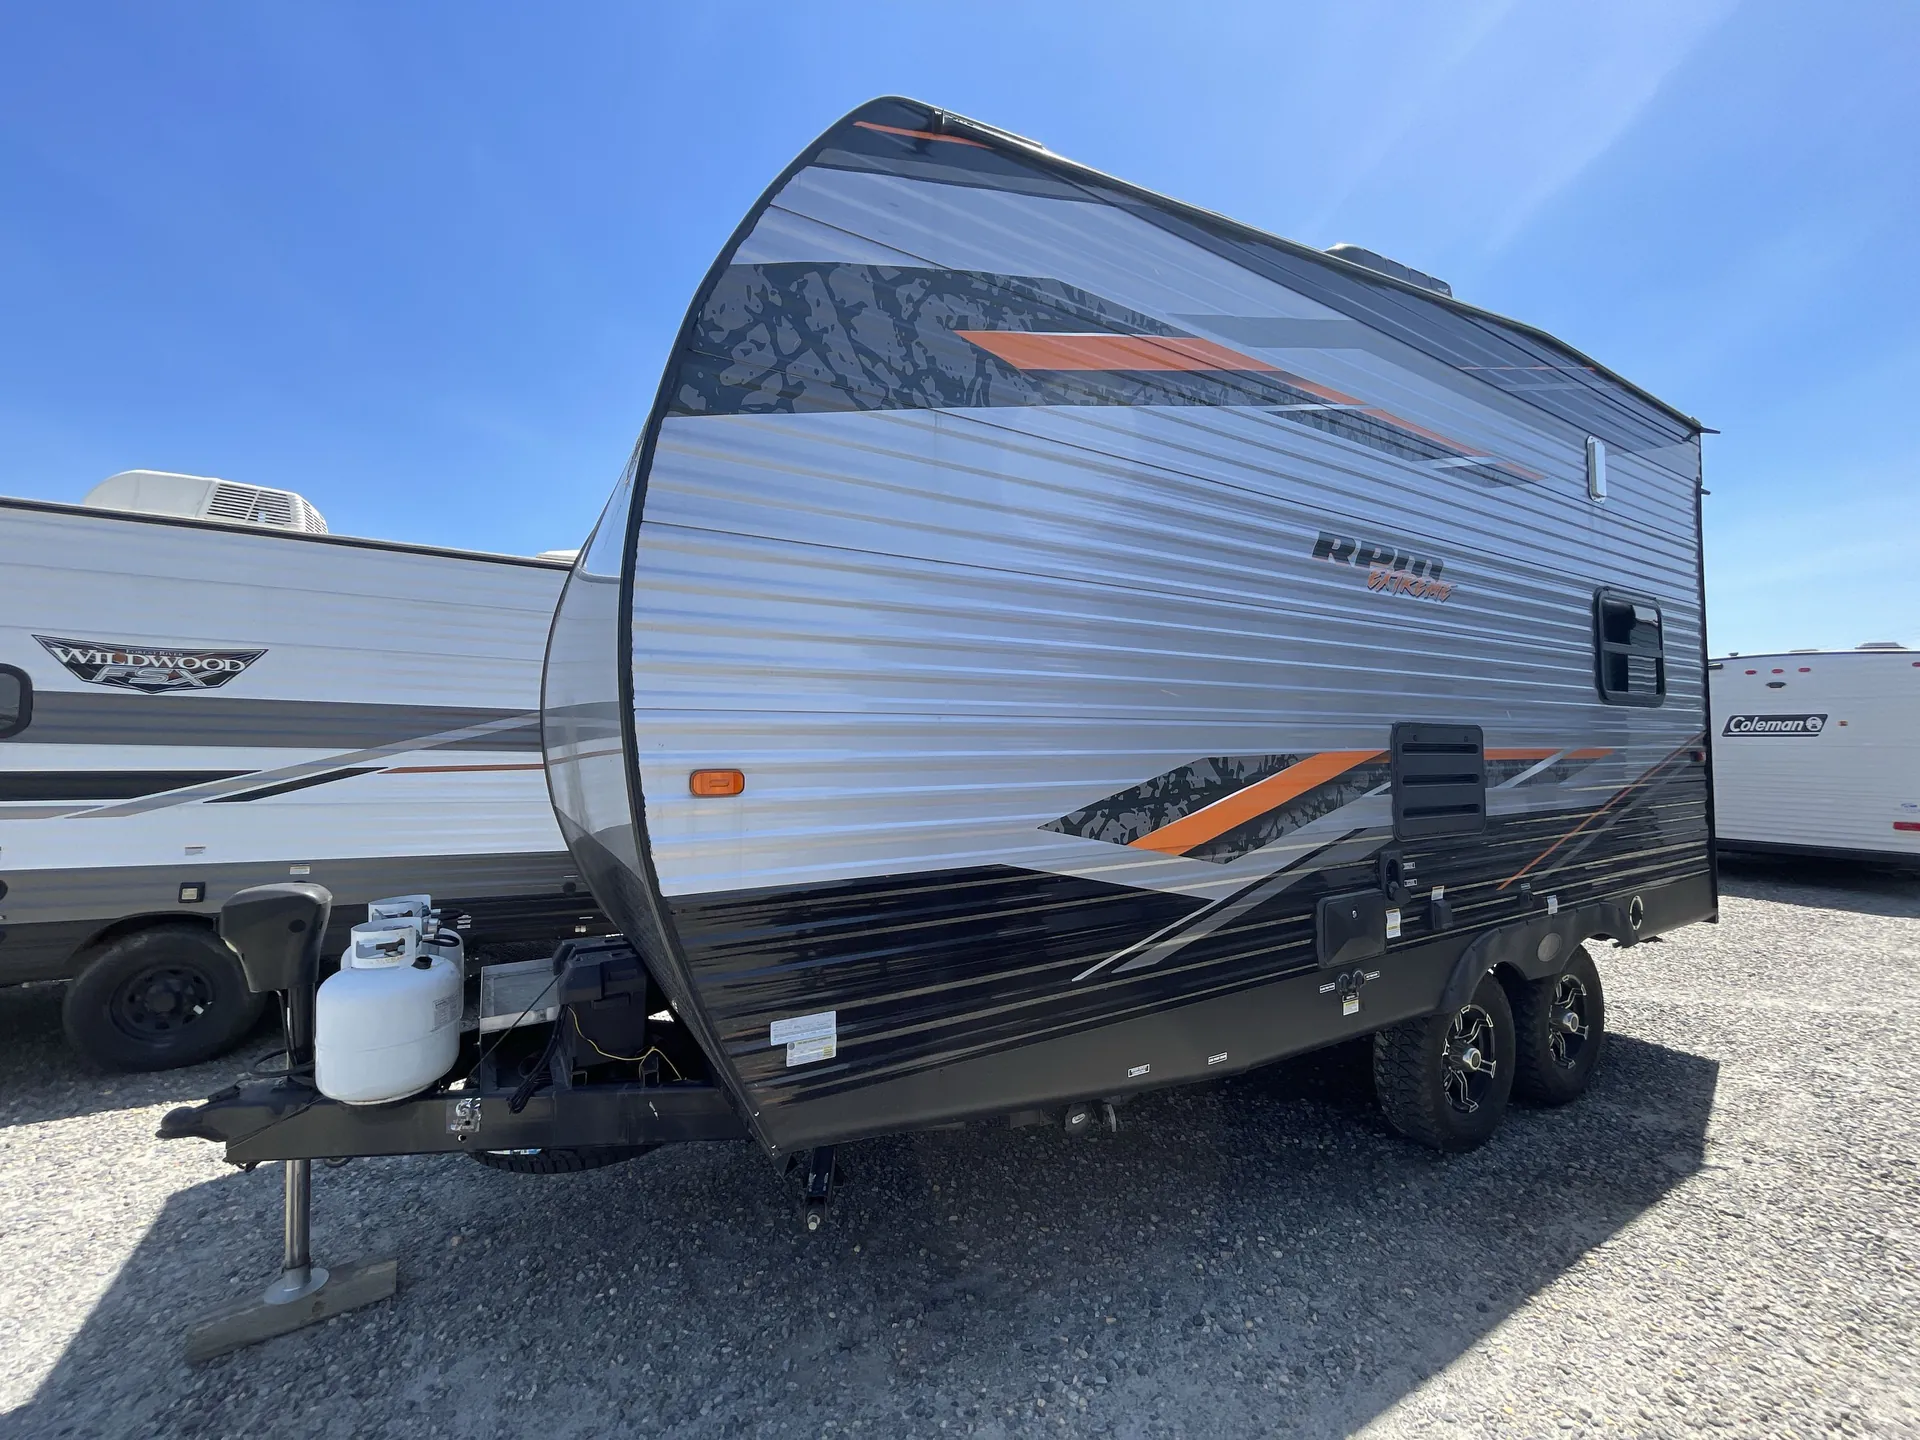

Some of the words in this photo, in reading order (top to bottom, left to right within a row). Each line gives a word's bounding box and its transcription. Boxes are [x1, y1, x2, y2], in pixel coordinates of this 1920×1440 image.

[50, 647, 247, 672] WILDWOOD
[94, 665, 220, 688] FSX
[1729, 716, 1804, 732] Coleman
